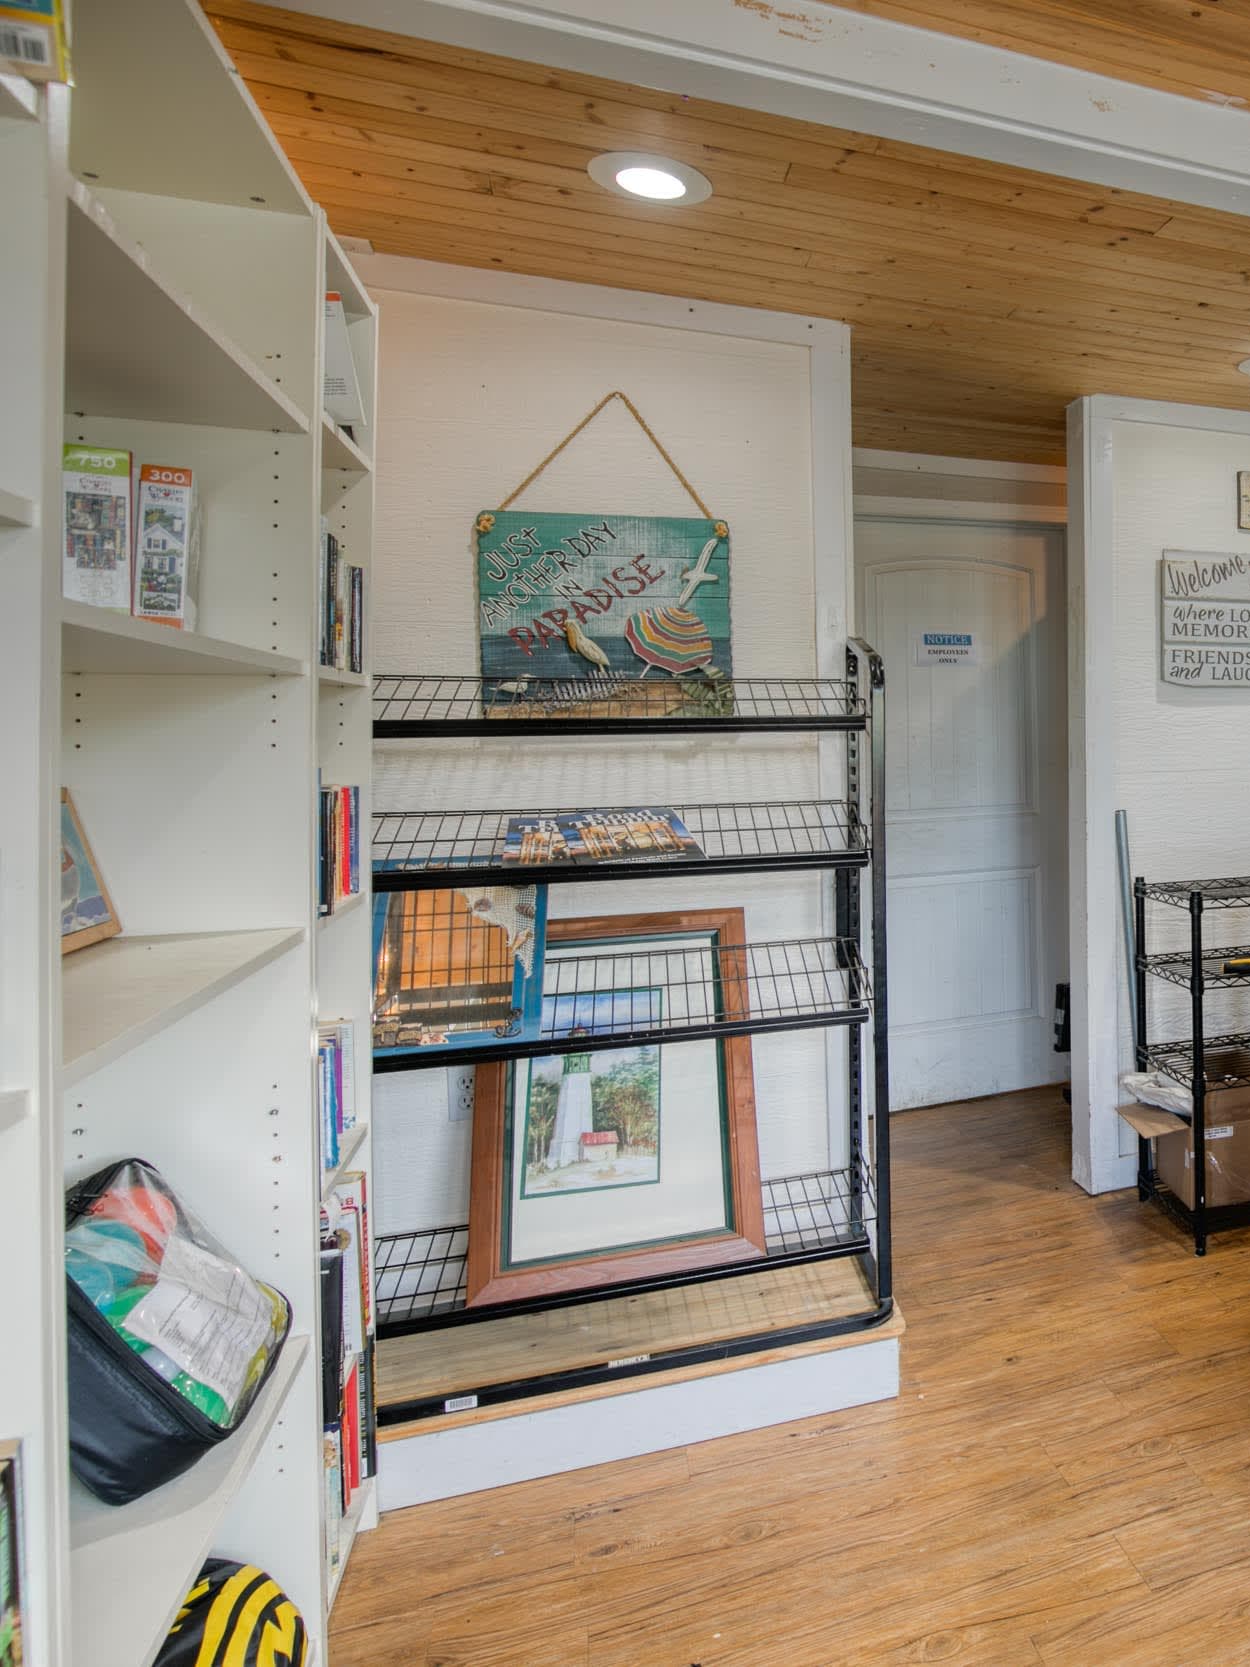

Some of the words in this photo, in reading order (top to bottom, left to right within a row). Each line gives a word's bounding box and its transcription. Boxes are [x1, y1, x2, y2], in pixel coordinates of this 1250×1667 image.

[80, 455, 116, 469] 750
[149, 469, 185, 483] 300
[486, 527, 541, 581] JUST
[480, 549, 579, 628] ANOTHER
[563, 521, 617, 559] DAY
[1168, 556, 1246, 596] Welcome
[554, 579, 583, 601] IN
[508, 554, 666, 656] PARADISE
[1173, 604, 1225, 620] where
[927, 635, 969, 644] NOTICE
[1169, 664, 1203, 680] and
